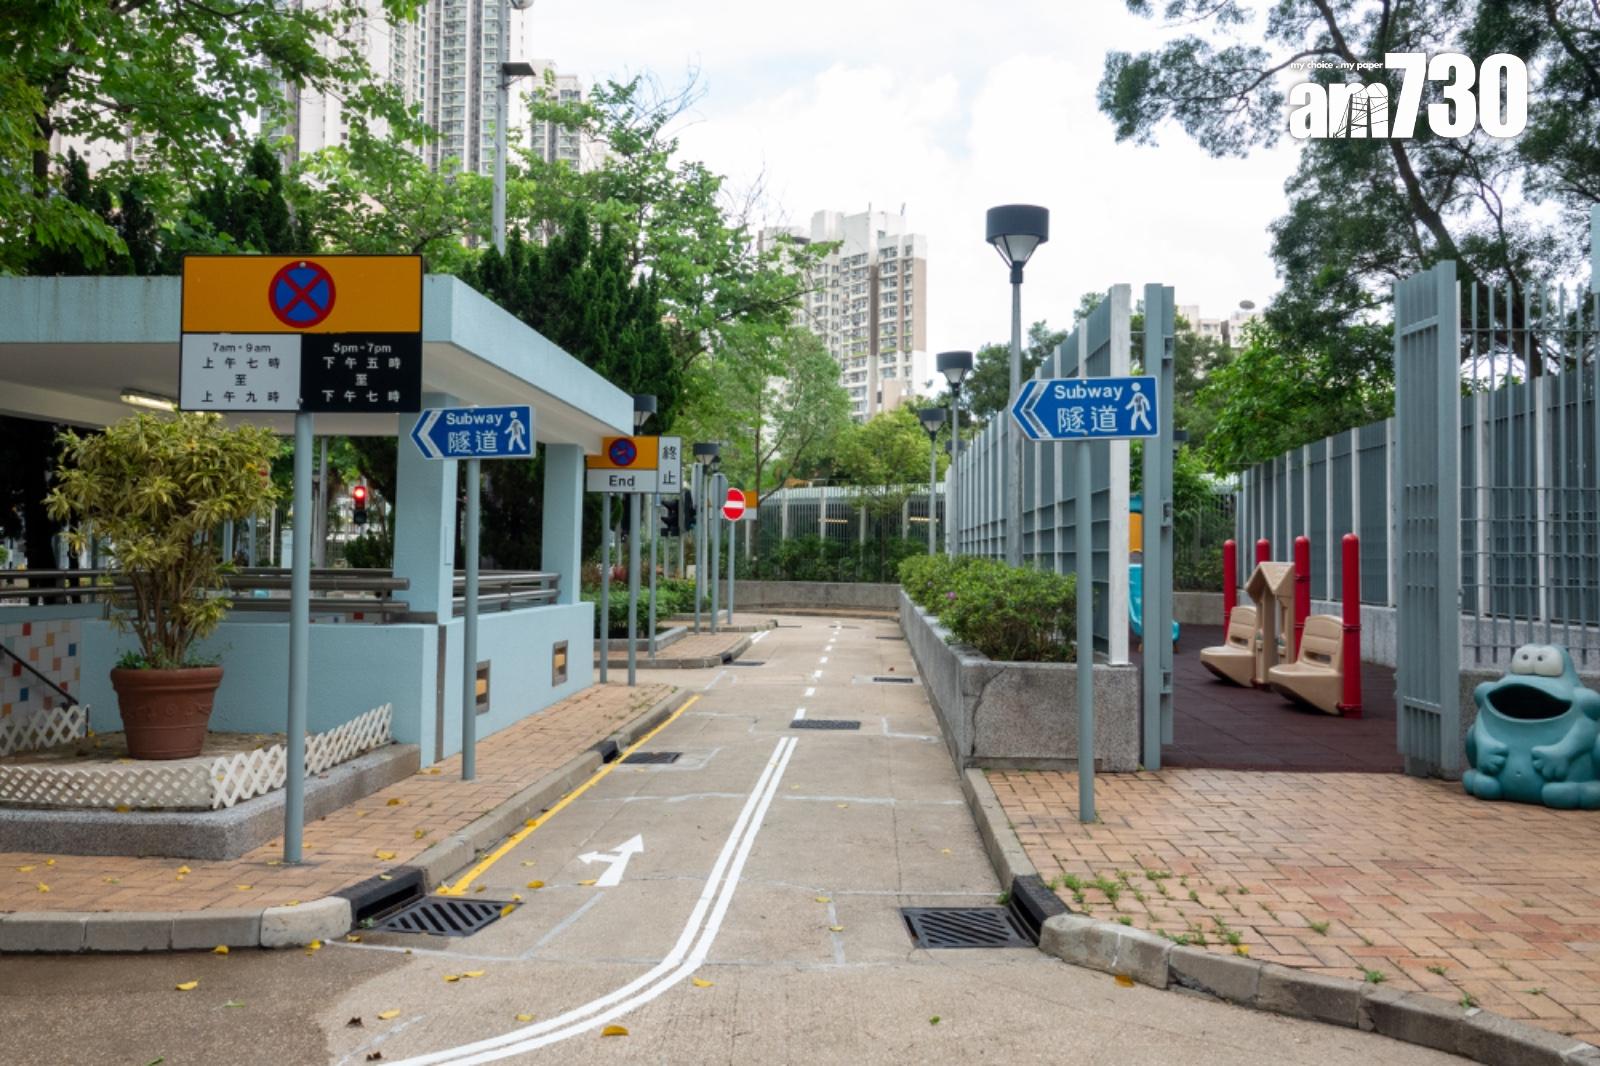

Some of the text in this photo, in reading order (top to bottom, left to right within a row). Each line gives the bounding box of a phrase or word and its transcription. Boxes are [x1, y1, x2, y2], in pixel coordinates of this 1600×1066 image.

[202, 357, 281, 369] 上午七時
[323, 356, 400, 369] 下午五時
[235, 374, 247, 386] 至
[355, 374, 368, 386] 至
[201, 391, 280, 402] 上午九時
[322, 390, 400, 403] 下午七時
[1054, 385, 1123, 401] Subway
[446, 413, 503, 426] Subway
[1057, 405, 1119, 434] 隧道
[448, 430, 498, 453] 隧道
[662, 446, 677, 485] 終止
[609, 475, 635, 487] End
